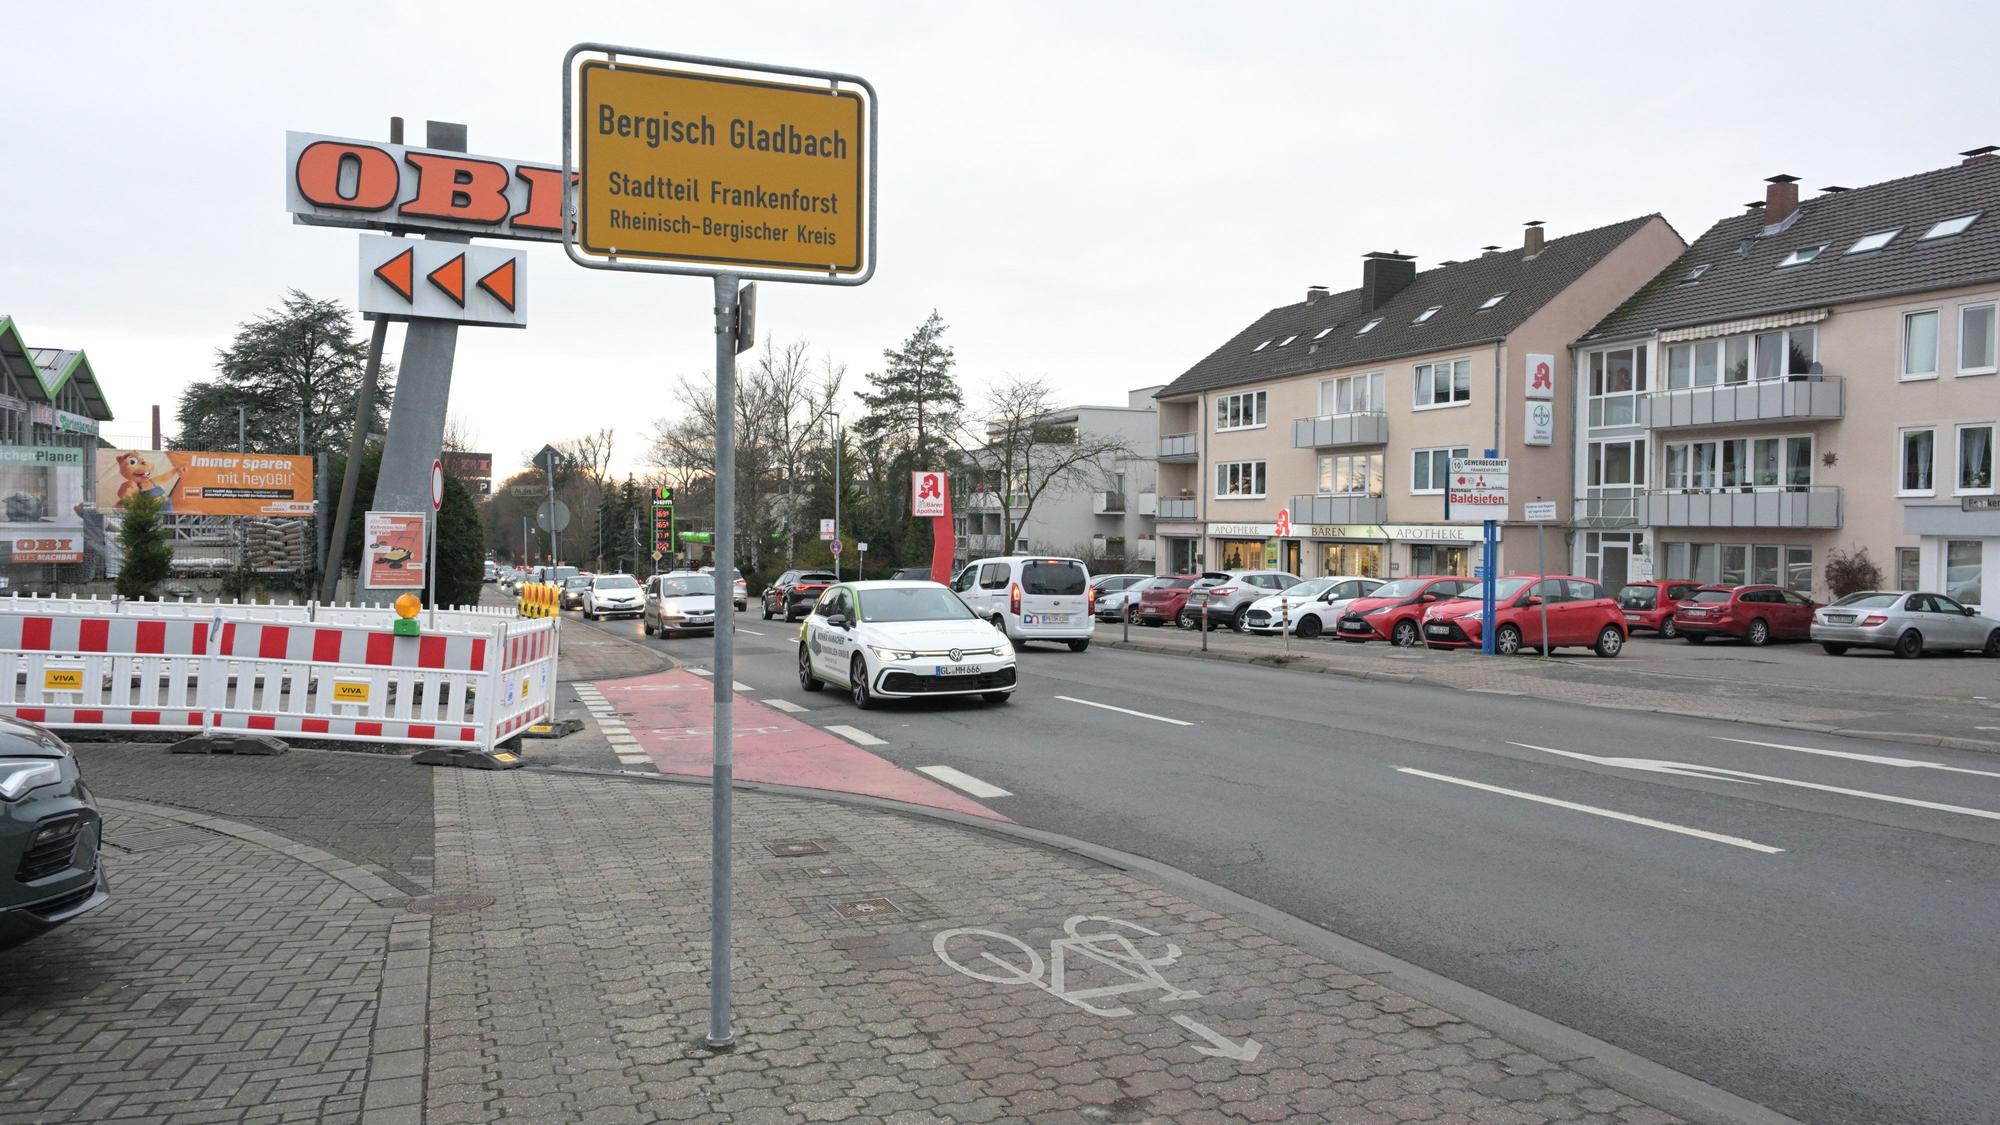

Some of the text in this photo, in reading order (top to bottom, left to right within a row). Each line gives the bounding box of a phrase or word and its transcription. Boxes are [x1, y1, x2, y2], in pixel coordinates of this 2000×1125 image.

[599, 103, 847, 160] Bergisch Gladbach
[296, 140, 580, 236] OBI
[608, 171, 838, 215] Stadtteil Frankenforst
[609, 208, 836, 246] Rheinisch-Bergischer Kreis
[191, 455, 292, 471] Immer sparen
[1464, 459, 1507, 467] GEWERBEGEBIET
[217, 473, 238, 484] mit
[1451, 494, 1504, 504] Baldsiefen
[1215, 526, 1260, 535] APOTHEKE
[1396, 528, 1464, 539] APOTHEKE
[16, 539, 72, 551] OBI
[941, 665, 981, 675] GL MH 666
